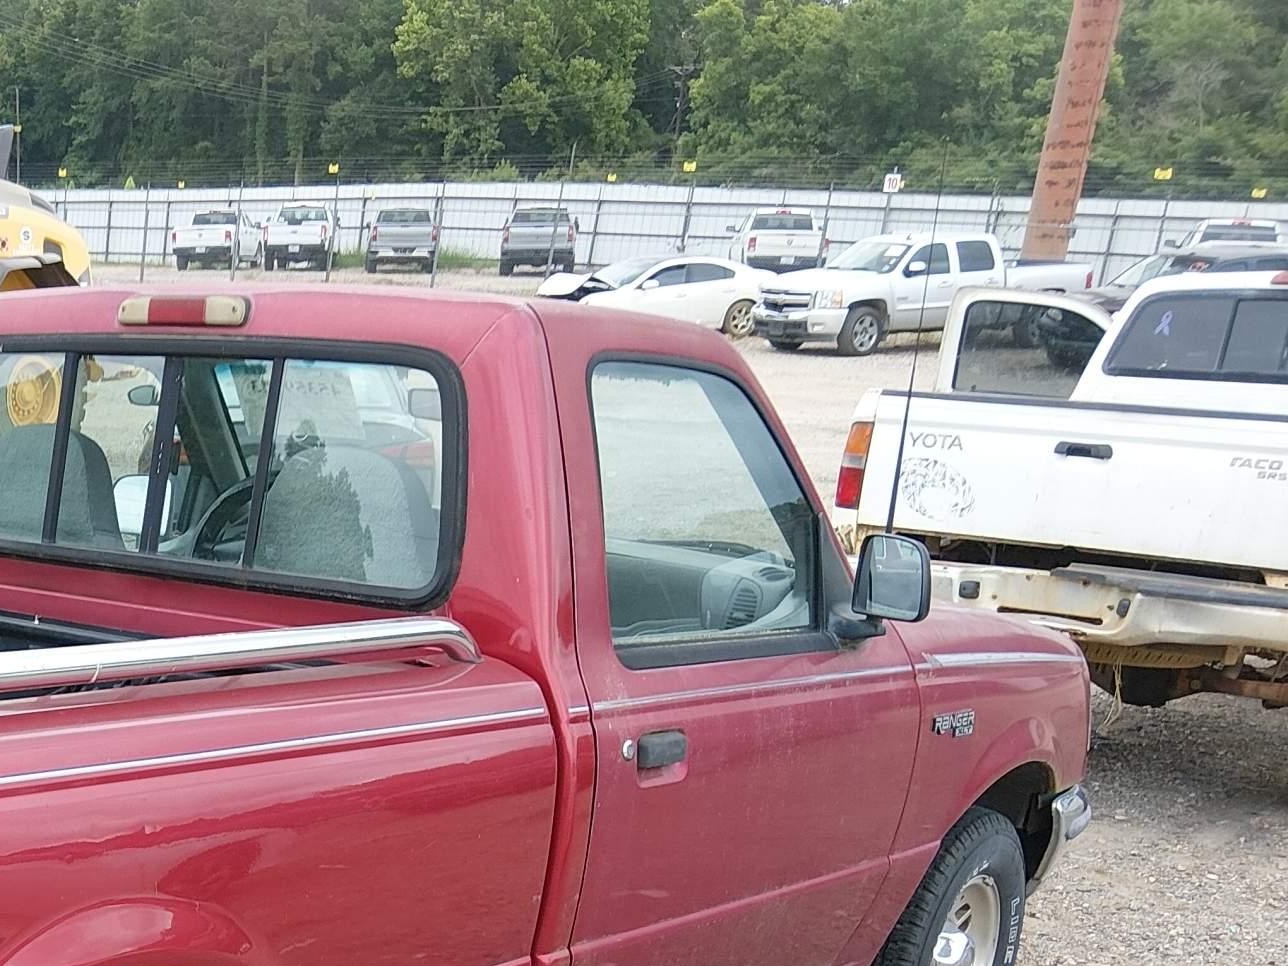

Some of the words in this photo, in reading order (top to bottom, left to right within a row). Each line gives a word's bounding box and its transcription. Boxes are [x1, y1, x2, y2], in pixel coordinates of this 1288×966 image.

[887, 177, 898, 190] 10
[909, 432, 963, 451] YOTA
[1229, 457, 1283, 470] TACO
